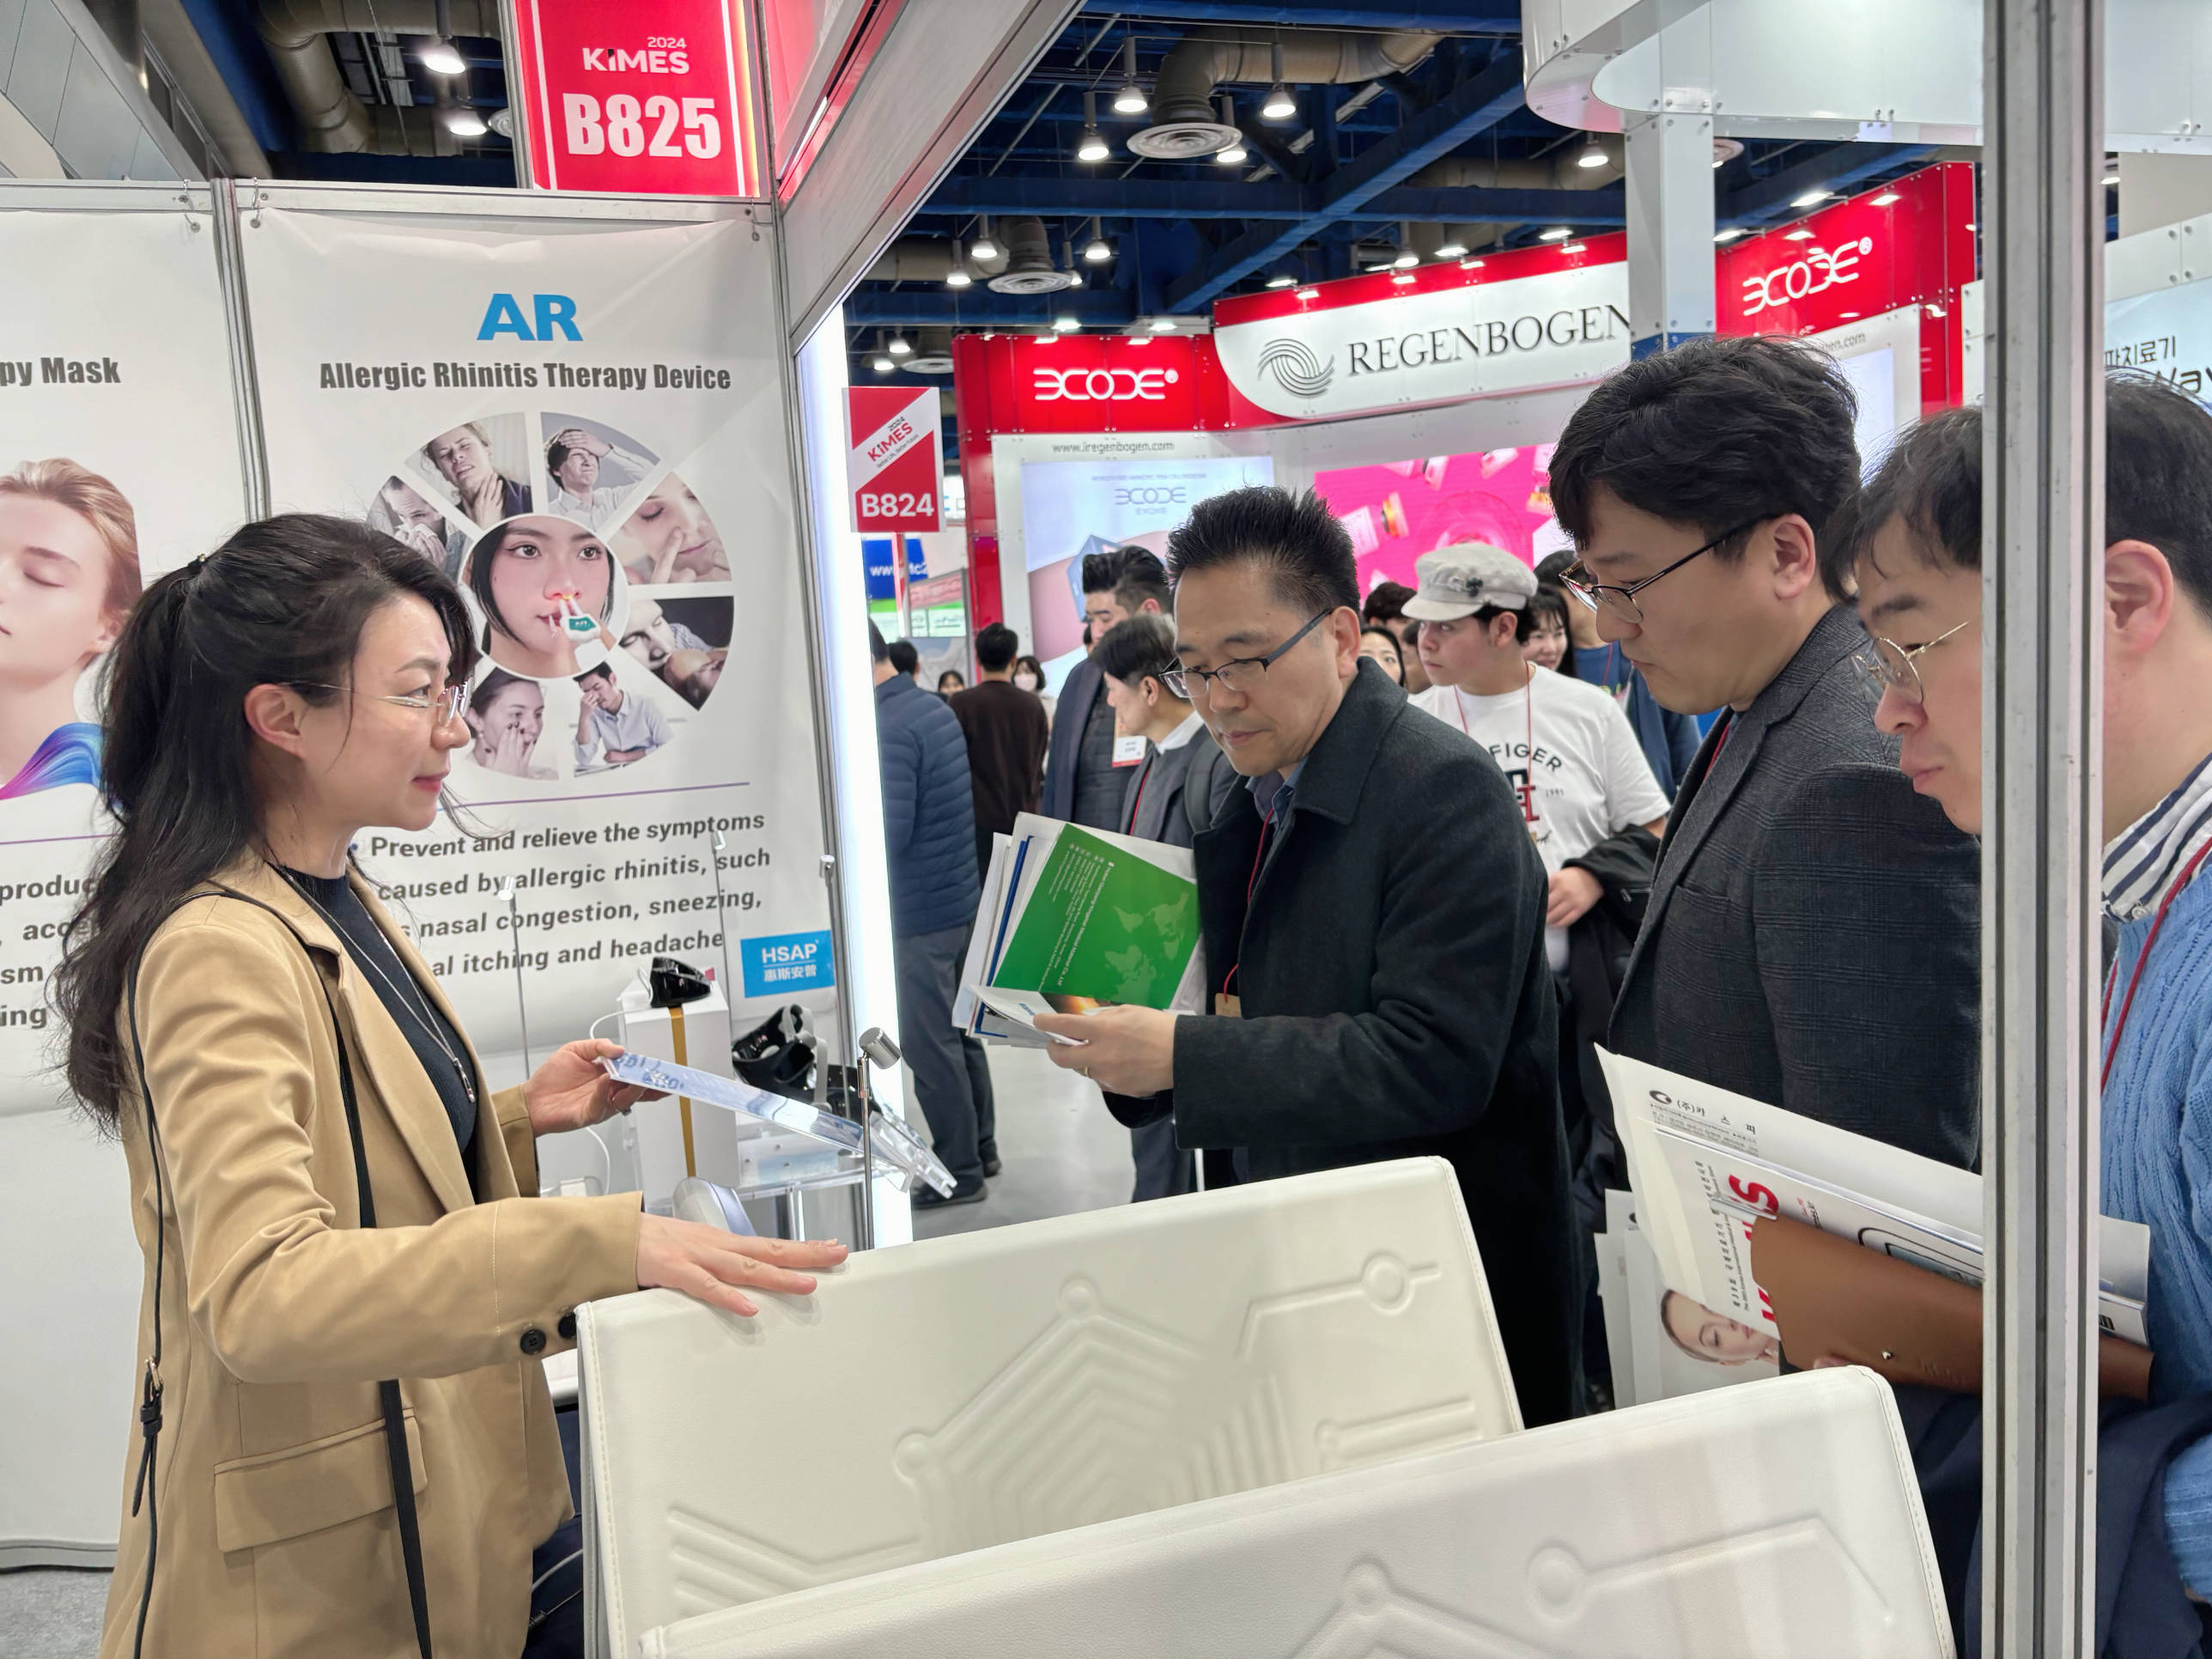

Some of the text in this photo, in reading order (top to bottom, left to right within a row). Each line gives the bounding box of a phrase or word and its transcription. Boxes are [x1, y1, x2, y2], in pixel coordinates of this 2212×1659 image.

[647, 37, 687, 49] 2024
[562, 93, 721, 160] B825
[477, 293, 584, 342] AR
[1346, 303, 1630, 378] REGENBOGEN
[2105, 335, 2175, 365] 파치료기
[0, 356, 122, 387] py Mask
[320, 362, 731, 391] Allergic Rhinitis Therapy Device
[861, 493, 935, 518] B824
[371, 815, 765, 858] Prevent and relieve the symptoms
[0, 874, 98, 906] produc
[379, 848, 770, 901] caused by allergic rhinitis, such
[420, 912, 487, 938] nasal
[496, 902, 639, 931] congestion,
[649, 890, 762, 915] sneezing,
[433, 930, 724, 976] al itching and headache
[762, 943, 817, 963] HSAP
[0, 965, 43, 985] sm
[0, 1005, 47, 1030] ing
